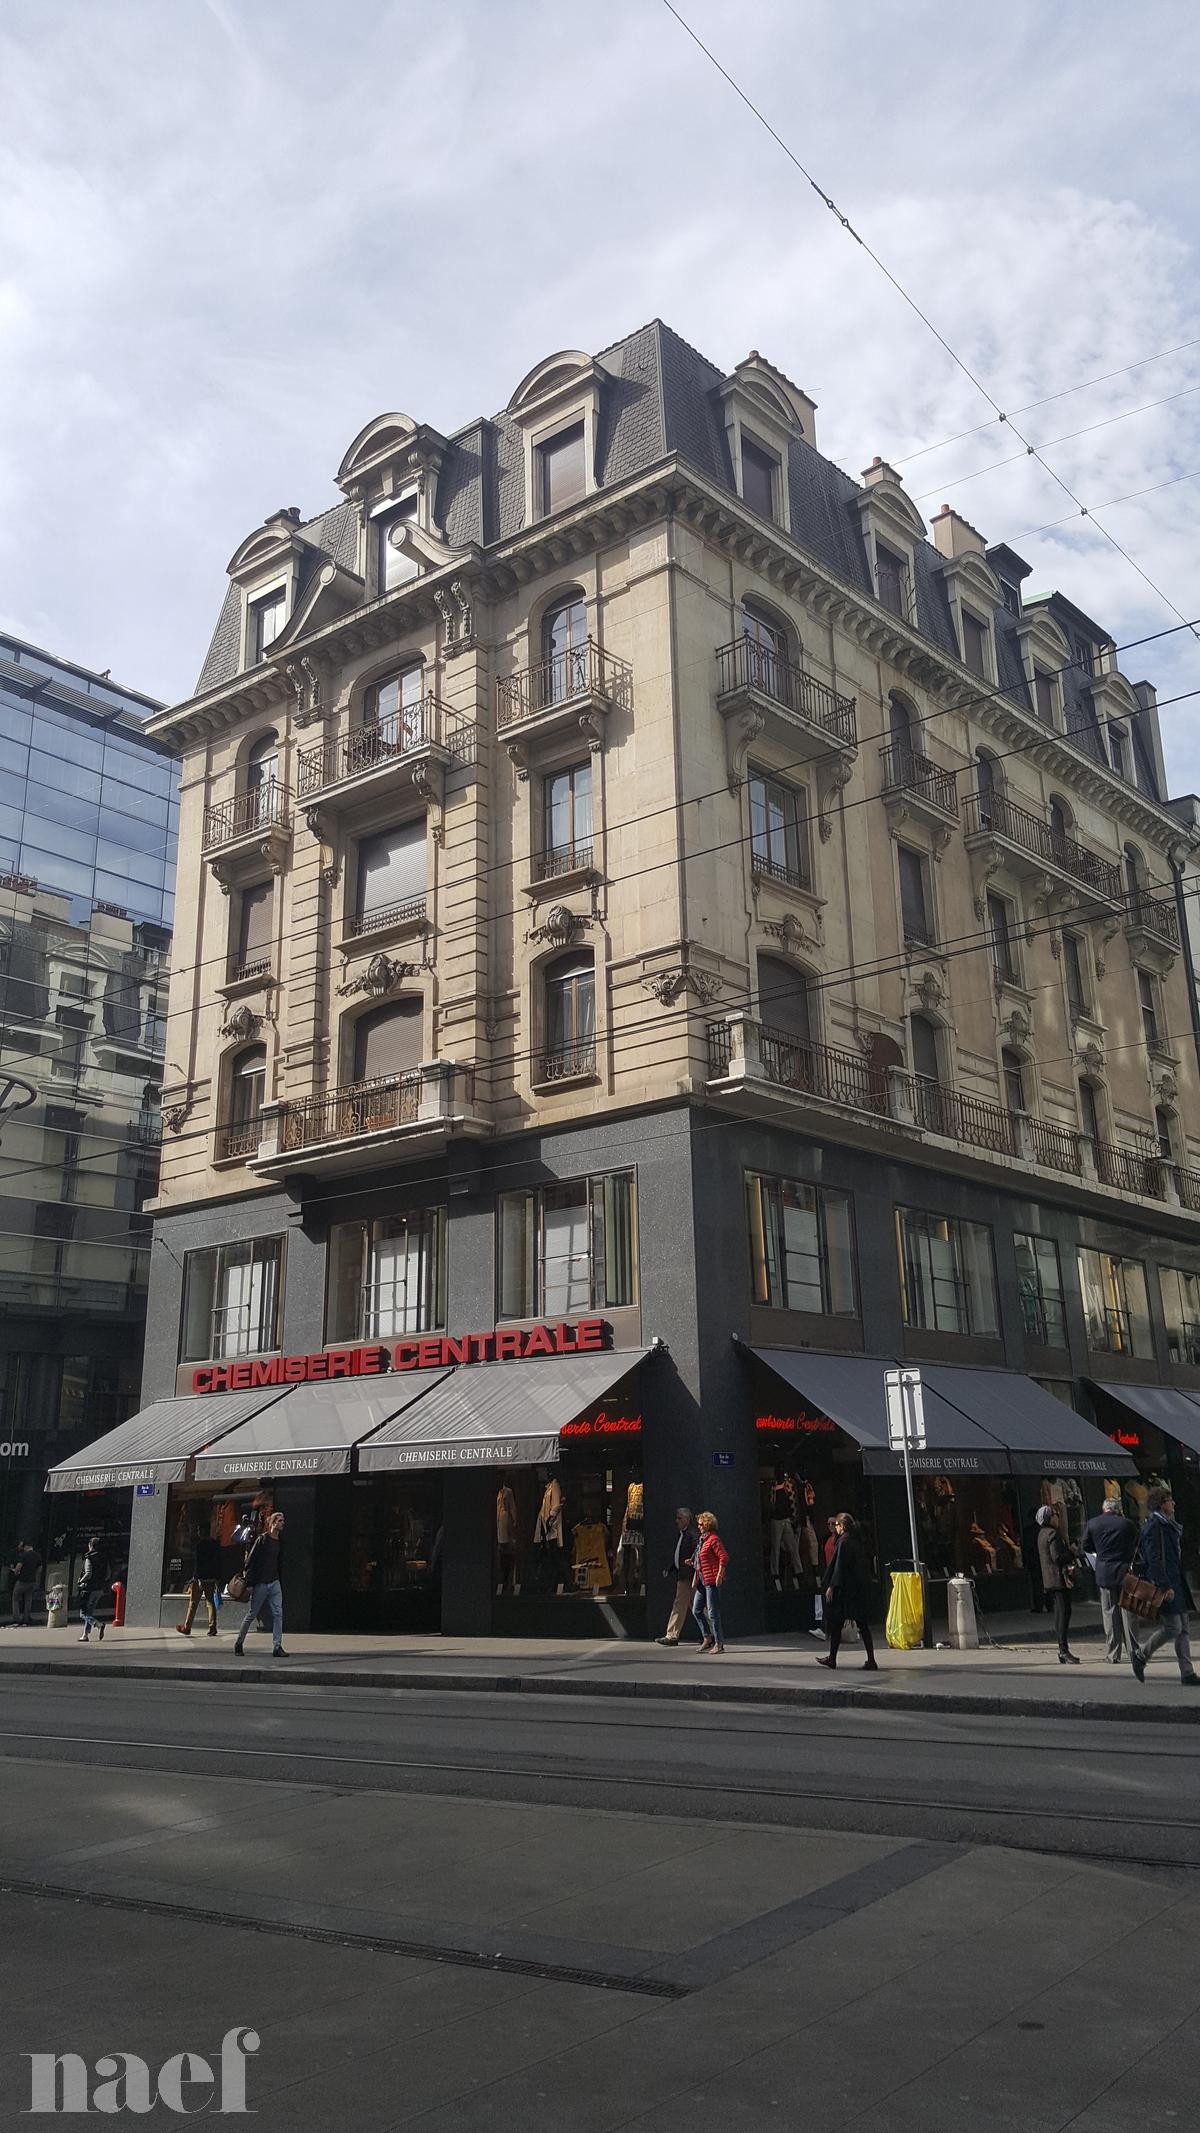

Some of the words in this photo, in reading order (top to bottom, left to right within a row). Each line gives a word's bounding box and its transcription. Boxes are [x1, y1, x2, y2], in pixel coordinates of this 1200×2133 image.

[192, 1345, 382, 1393] CHEMISERIE
[394, 1319, 604, 1369] CENTRALE
[398, 1449, 457, 1463] CHEMISERIE
[459, 1446, 513, 1460] CENTRALE
[223, 1461, 273, 1474] CHEMISERIE
[274, 1458, 318, 1471] CENTRALE
[898, 1457, 942, 1469] CEMISERIE
[943, 1457, 979, 1469] CENTRALE
[1043, 1459, 1078, 1470] CHEMISERIE
[1078, 1460, 1107, 1471] CENTRALE
[75, 1472, 116, 1486] CHEMISERIE
[117, 1469, 154, 1481] CENTRALE
